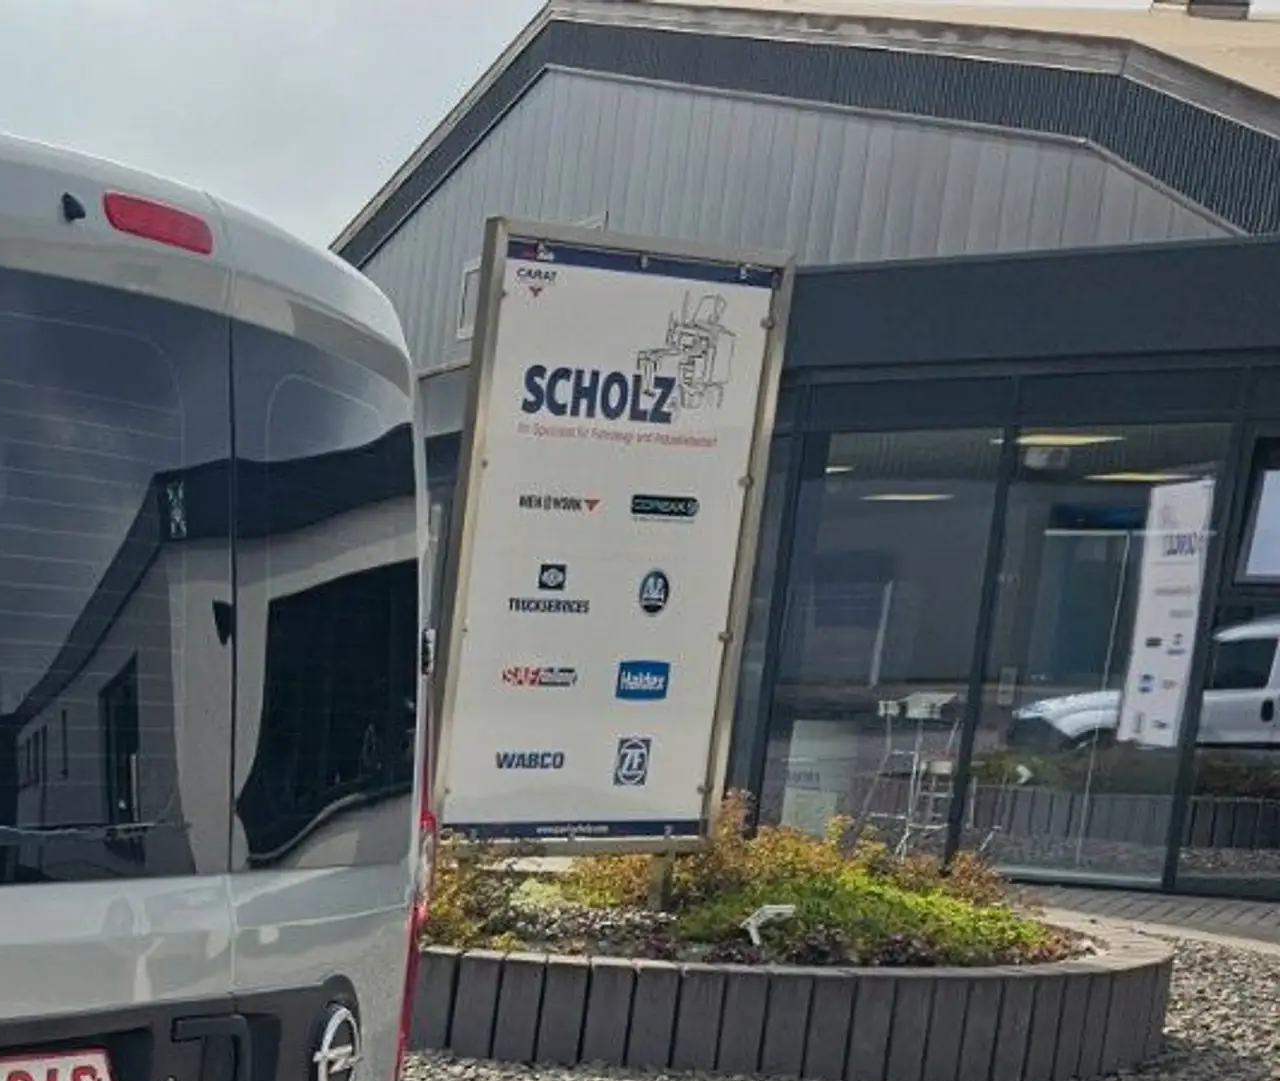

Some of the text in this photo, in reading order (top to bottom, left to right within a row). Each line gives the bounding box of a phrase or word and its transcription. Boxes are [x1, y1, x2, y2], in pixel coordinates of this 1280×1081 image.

[521, 364, 677, 424] SCHOLZ
[620, 671, 665, 691] Haldex
[496, 752, 565, 769] WABCO
